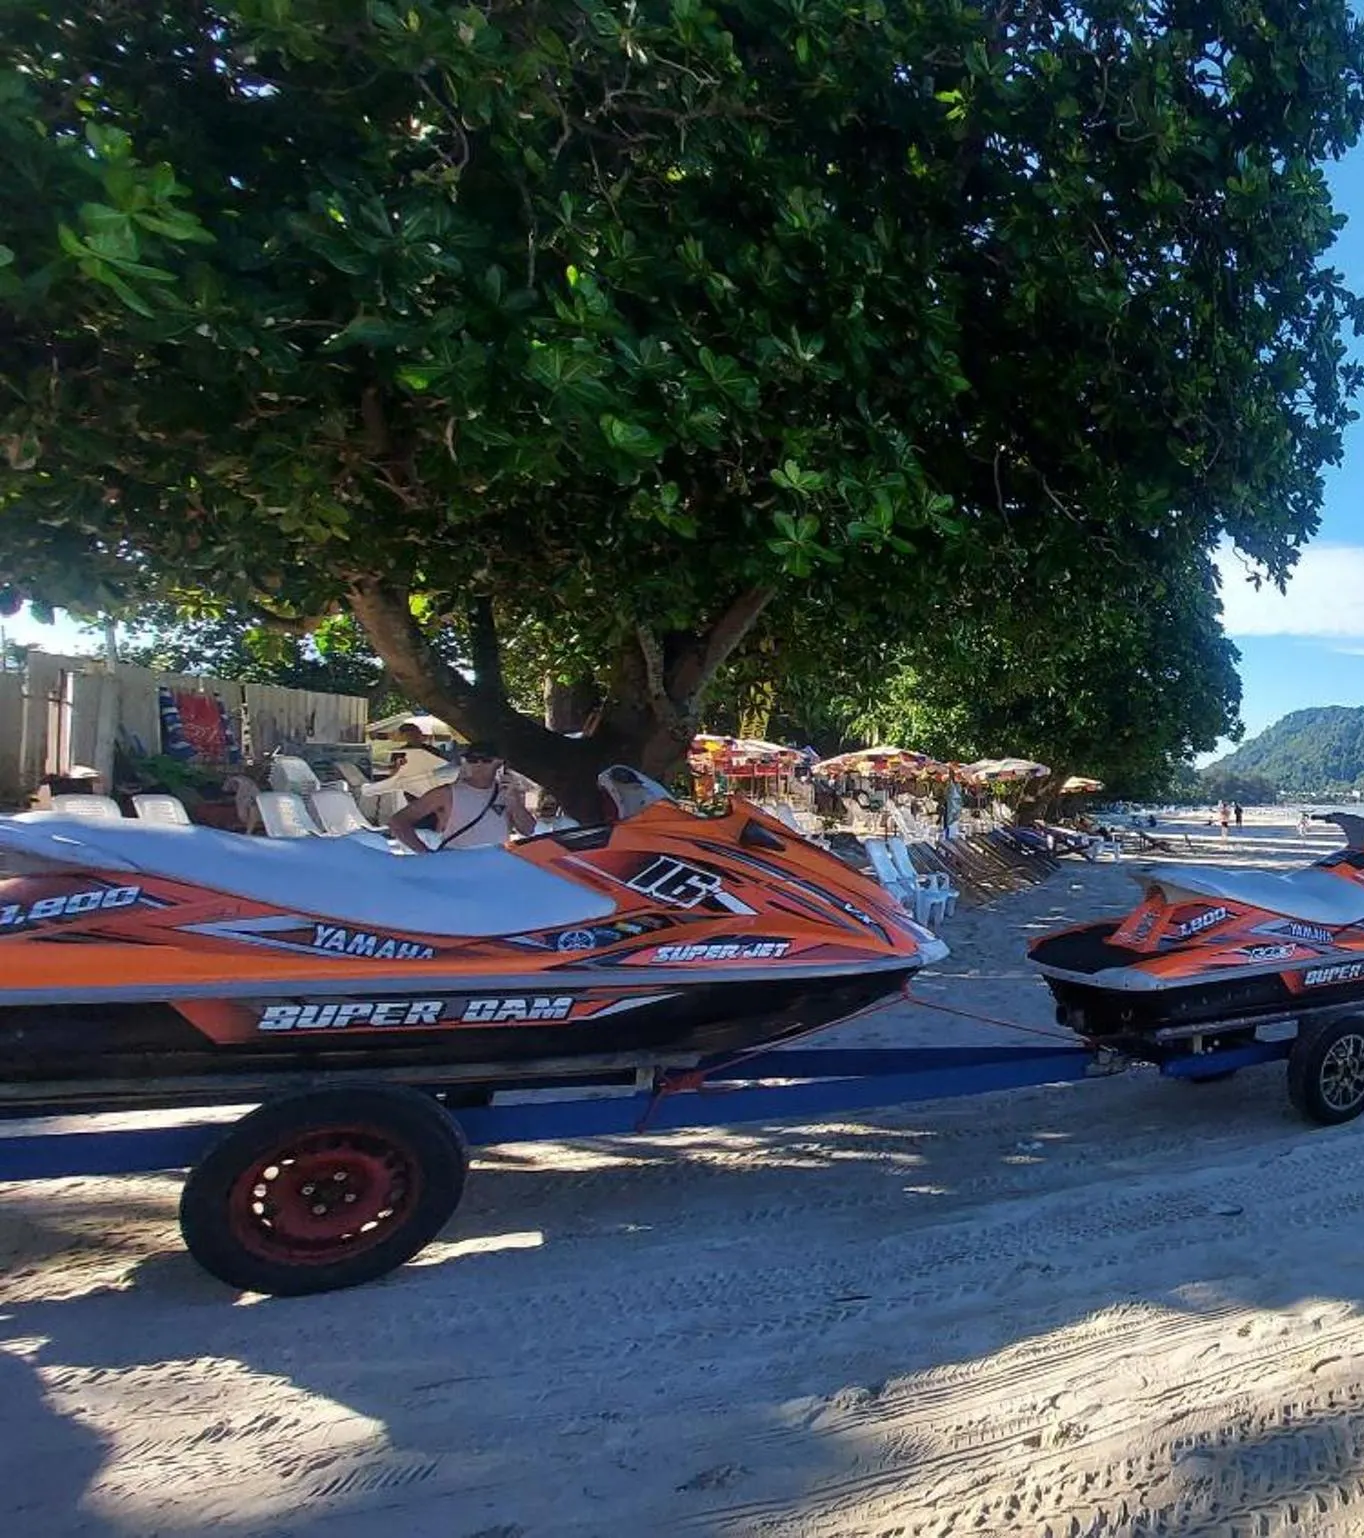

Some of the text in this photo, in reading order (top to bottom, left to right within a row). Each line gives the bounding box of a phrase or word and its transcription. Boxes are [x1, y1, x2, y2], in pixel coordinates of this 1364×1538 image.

[313, 923, 436, 959] YAMAHA
[1289, 922, 1334, 942] YAMAHA
[651, 942, 790, 962] SUPER JET
[258, 1001, 444, 1030] SUPER
